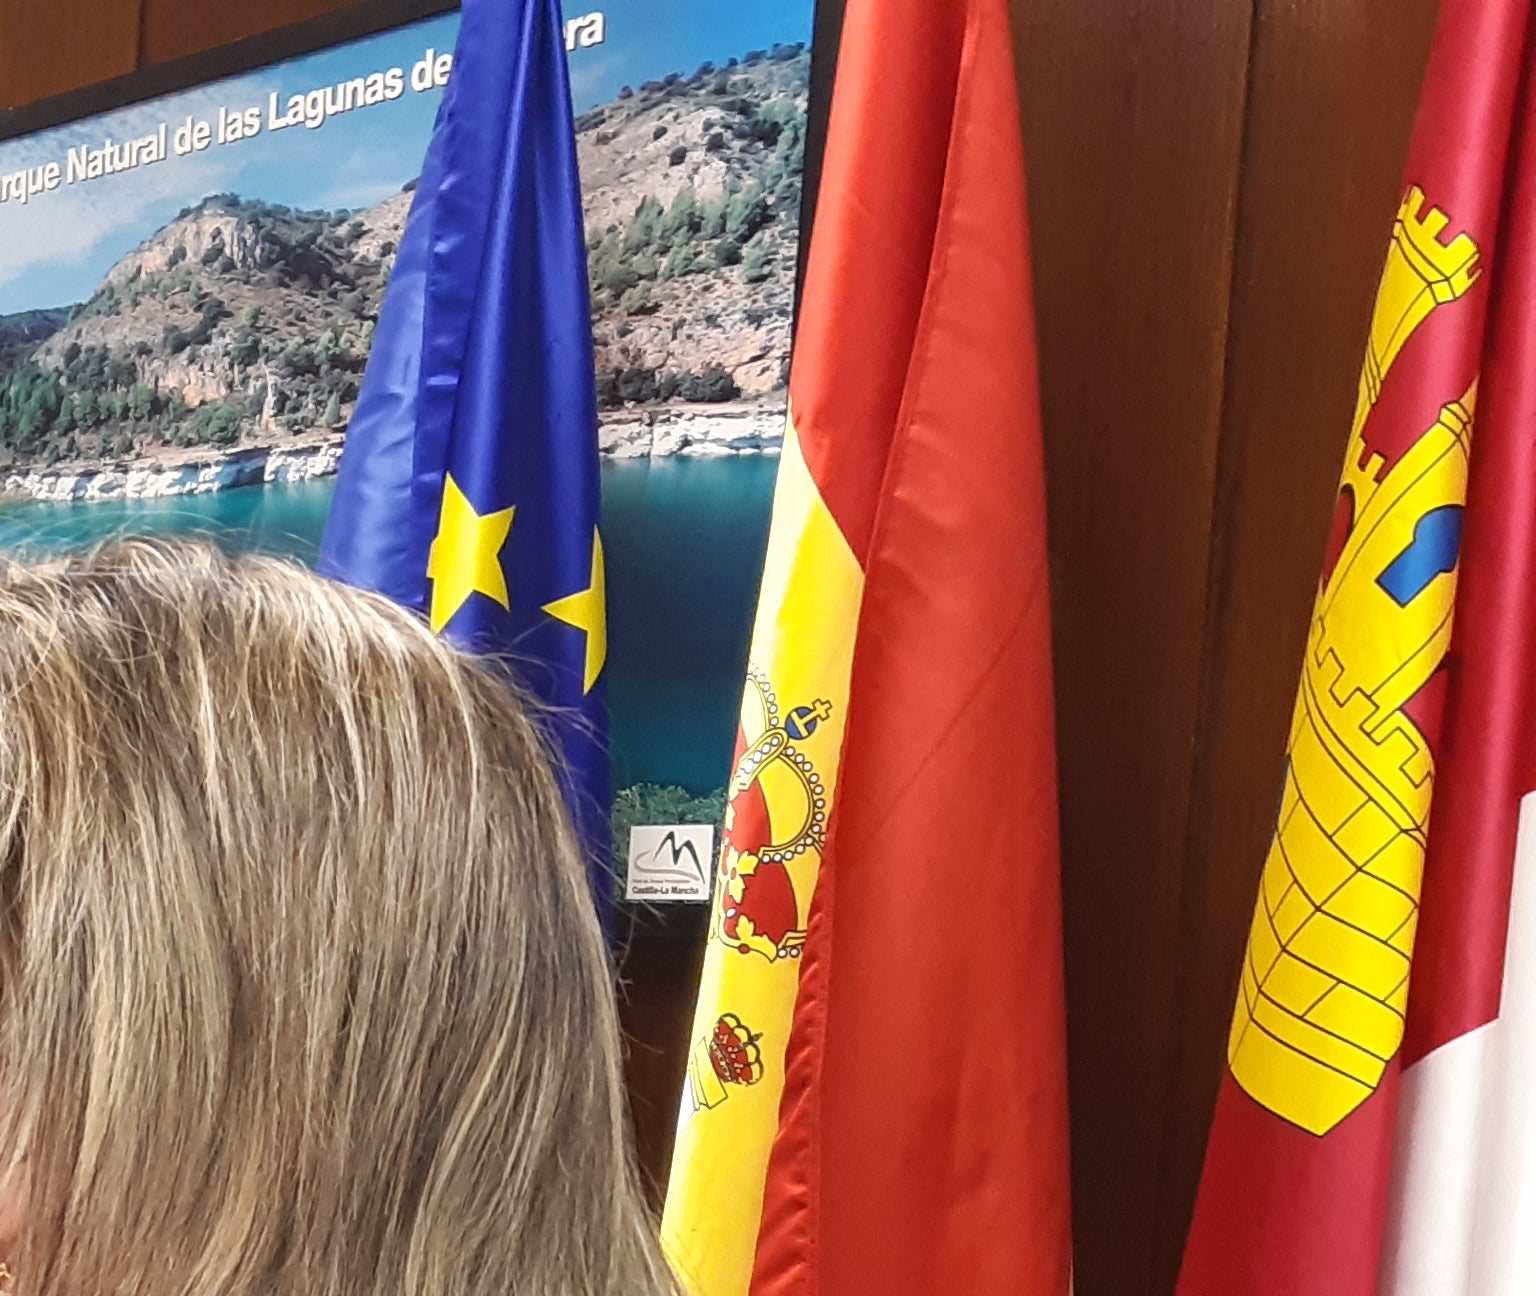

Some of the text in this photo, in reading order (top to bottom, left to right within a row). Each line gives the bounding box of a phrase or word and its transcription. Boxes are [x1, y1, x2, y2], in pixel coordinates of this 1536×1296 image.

[66, 122, 168, 184] Natural
[173, 115, 212, 156] de
[217, 106, 261, 144] las
[268, 67, 404, 130] Lagunas
[410, 48, 454, 93] de
